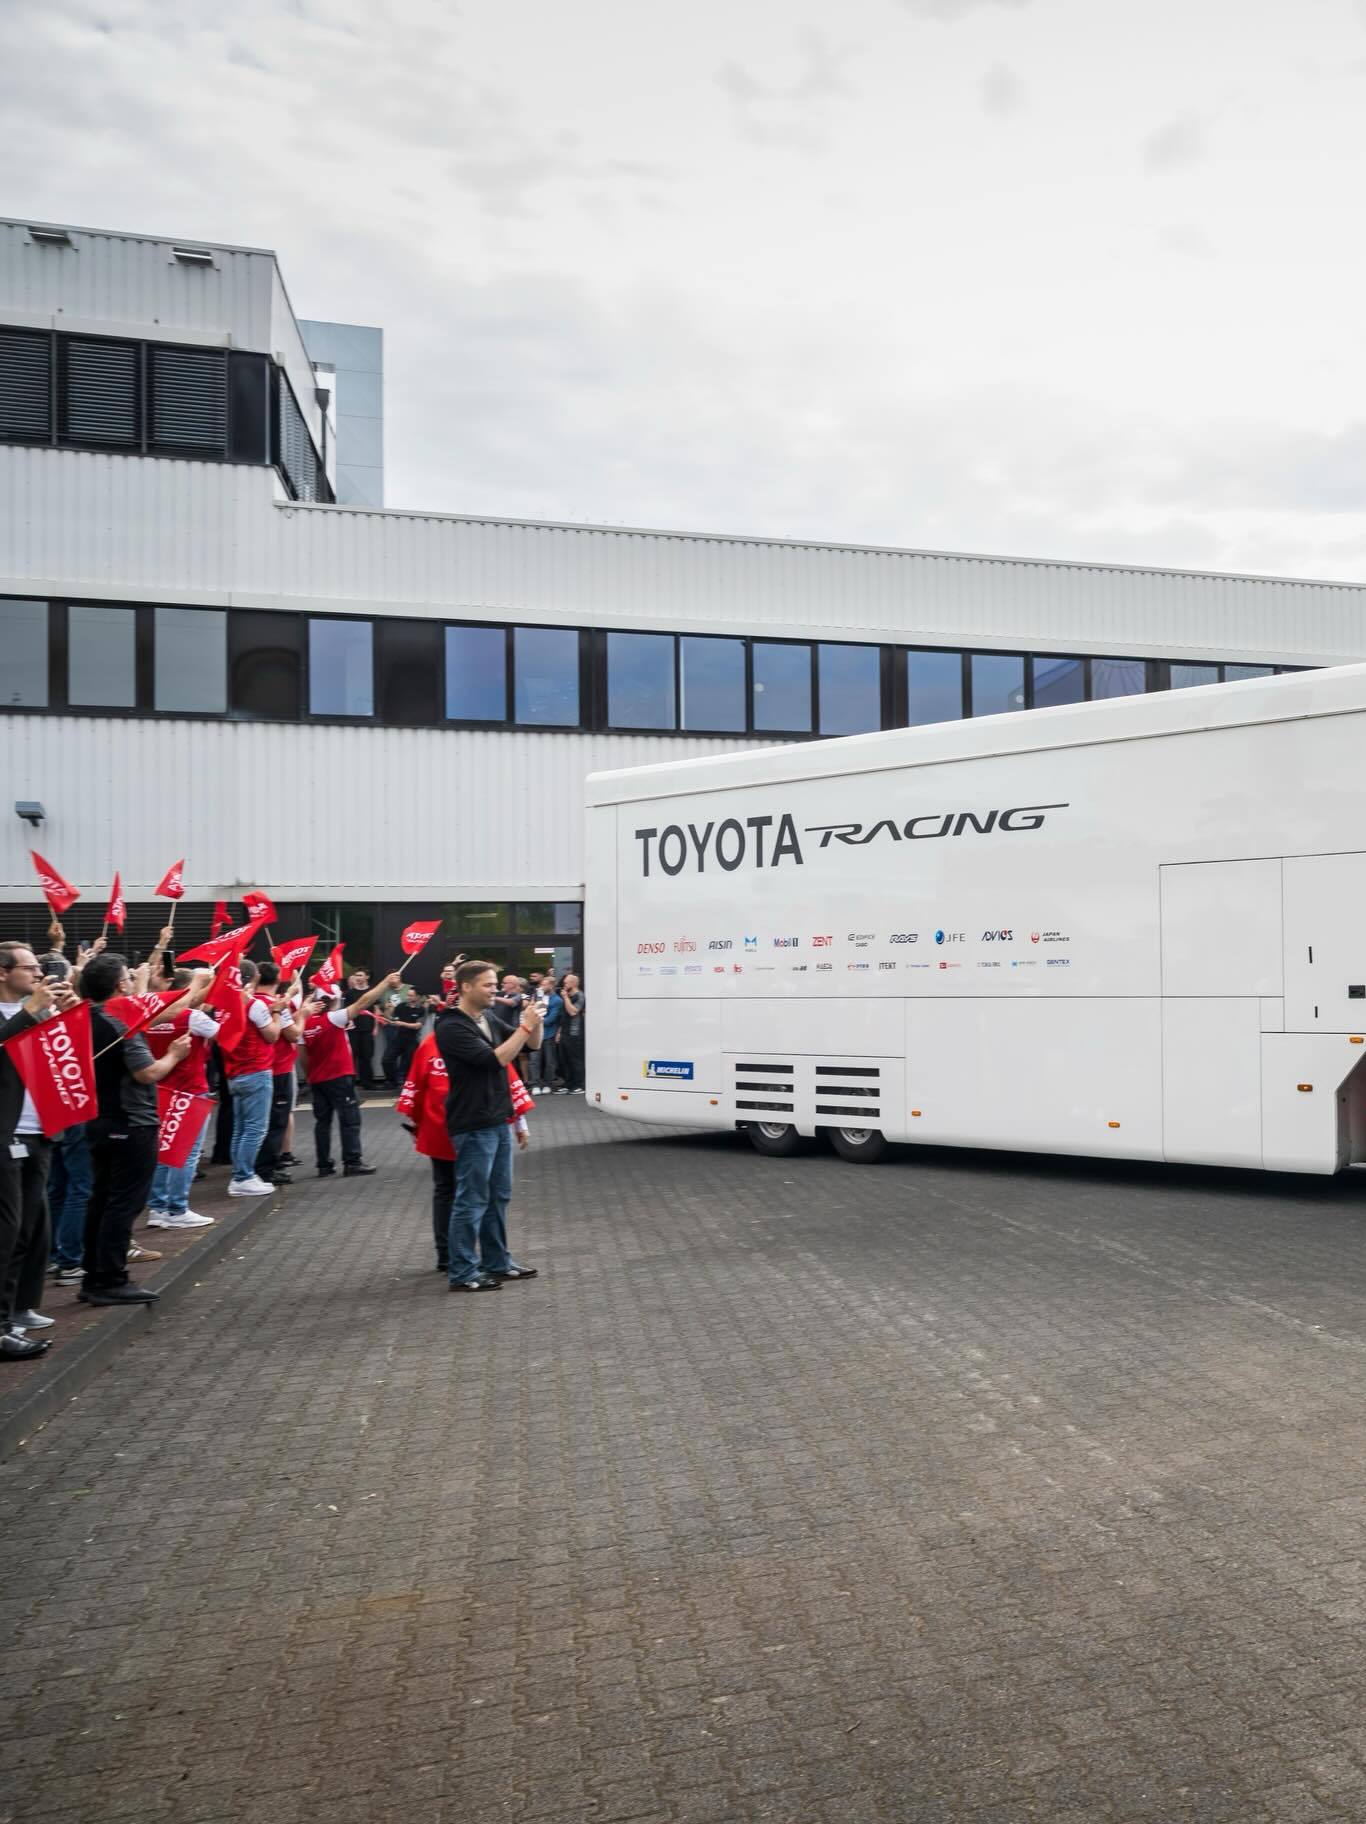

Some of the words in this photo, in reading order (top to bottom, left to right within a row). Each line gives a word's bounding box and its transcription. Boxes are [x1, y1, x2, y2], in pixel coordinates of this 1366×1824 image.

[635, 813, 804, 877] TOYOTA
[804, 803, 1070, 848] RACING
[889, 934, 918, 943] RAYS
[946, 933, 966, 942] JFE
[981, 930, 1014, 941] ADVICS
[708, 940, 733, 950] AISIN
[774, 938, 791, 948] Mobil
[812, 936, 833, 947] ZENT
[637, 942, 666, 954] DENSO
[48, 1021, 90, 1108] TOYOTA
[656, 1066, 690, 1075] MICHELIN
